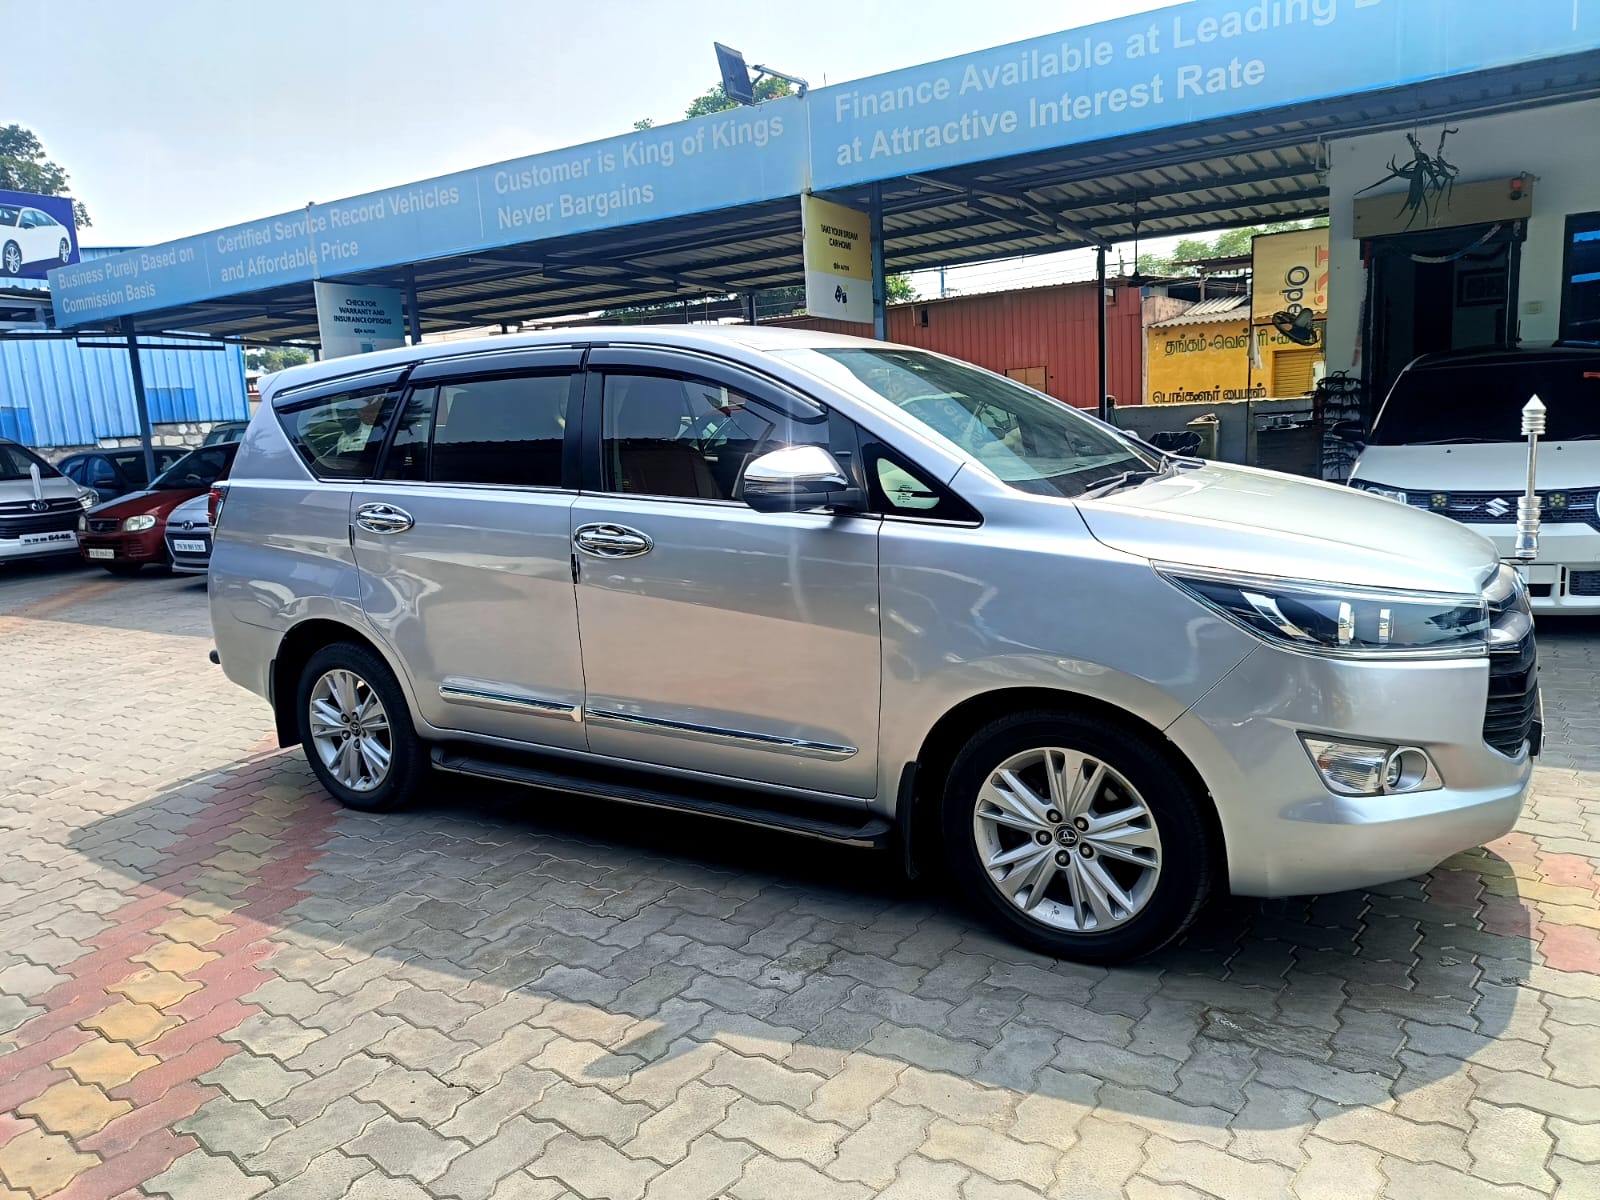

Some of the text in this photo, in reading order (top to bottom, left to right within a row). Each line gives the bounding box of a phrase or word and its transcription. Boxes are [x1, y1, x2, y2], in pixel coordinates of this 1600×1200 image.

[835, 0, 1337, 123] Finance Available at Leading
[836, 56, 1266, 166] at Attractive Interest Rate
[494, 115, 784, 194] Customer is King of Kings
[216, 186, 460, 255] Certified Service Record Vehicles
[497, 183, 655, 230] Never Bargains
[58, 247, 195, 290] Business Purely Based on
[221, 239, 359, 282] and Affordable Price
[62, 281, 157, 313] Commission Basis
[339, 307, 372, 316] WARRANTY
[1281, 266, 1310, 315] Ope
